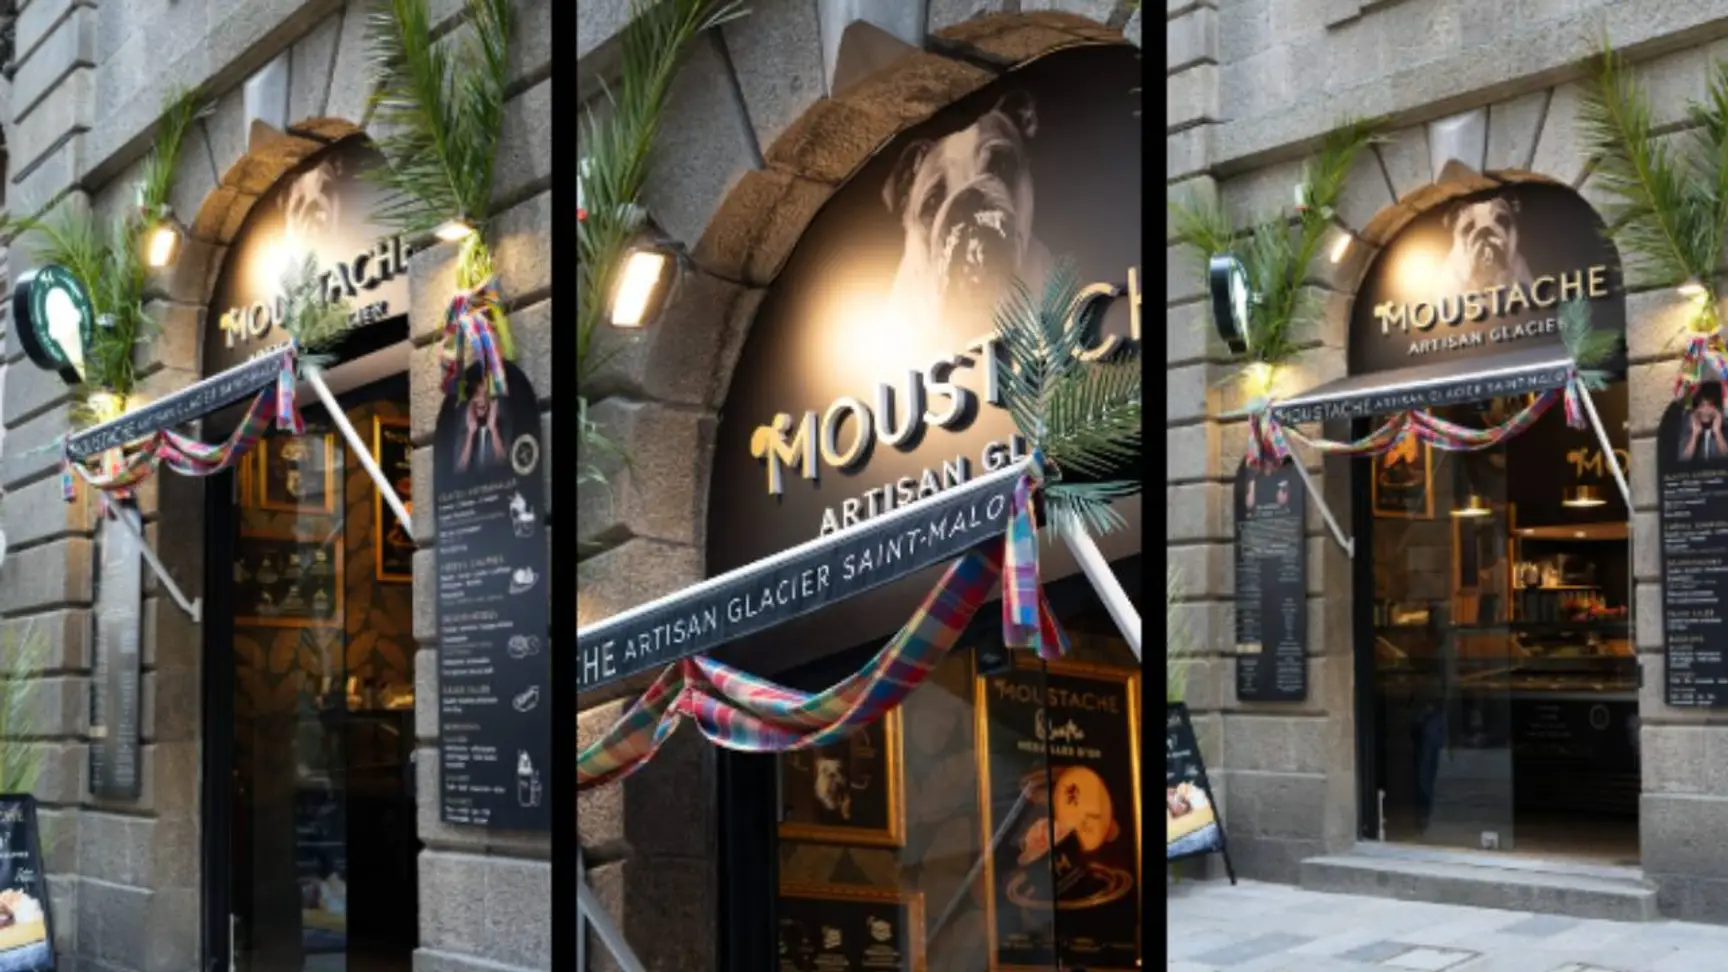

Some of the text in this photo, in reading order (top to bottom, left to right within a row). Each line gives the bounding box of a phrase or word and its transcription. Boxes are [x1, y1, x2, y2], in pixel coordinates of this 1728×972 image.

[1374, 264, 1608, 334] MOUSTACHE
[1409, 331, 1482, 355] ARTISAN
[819, 455, 967, 535] ARTISAN
[577, 494, 1006, 684] HE ARTISAN GLACIER SAINT-MALO
